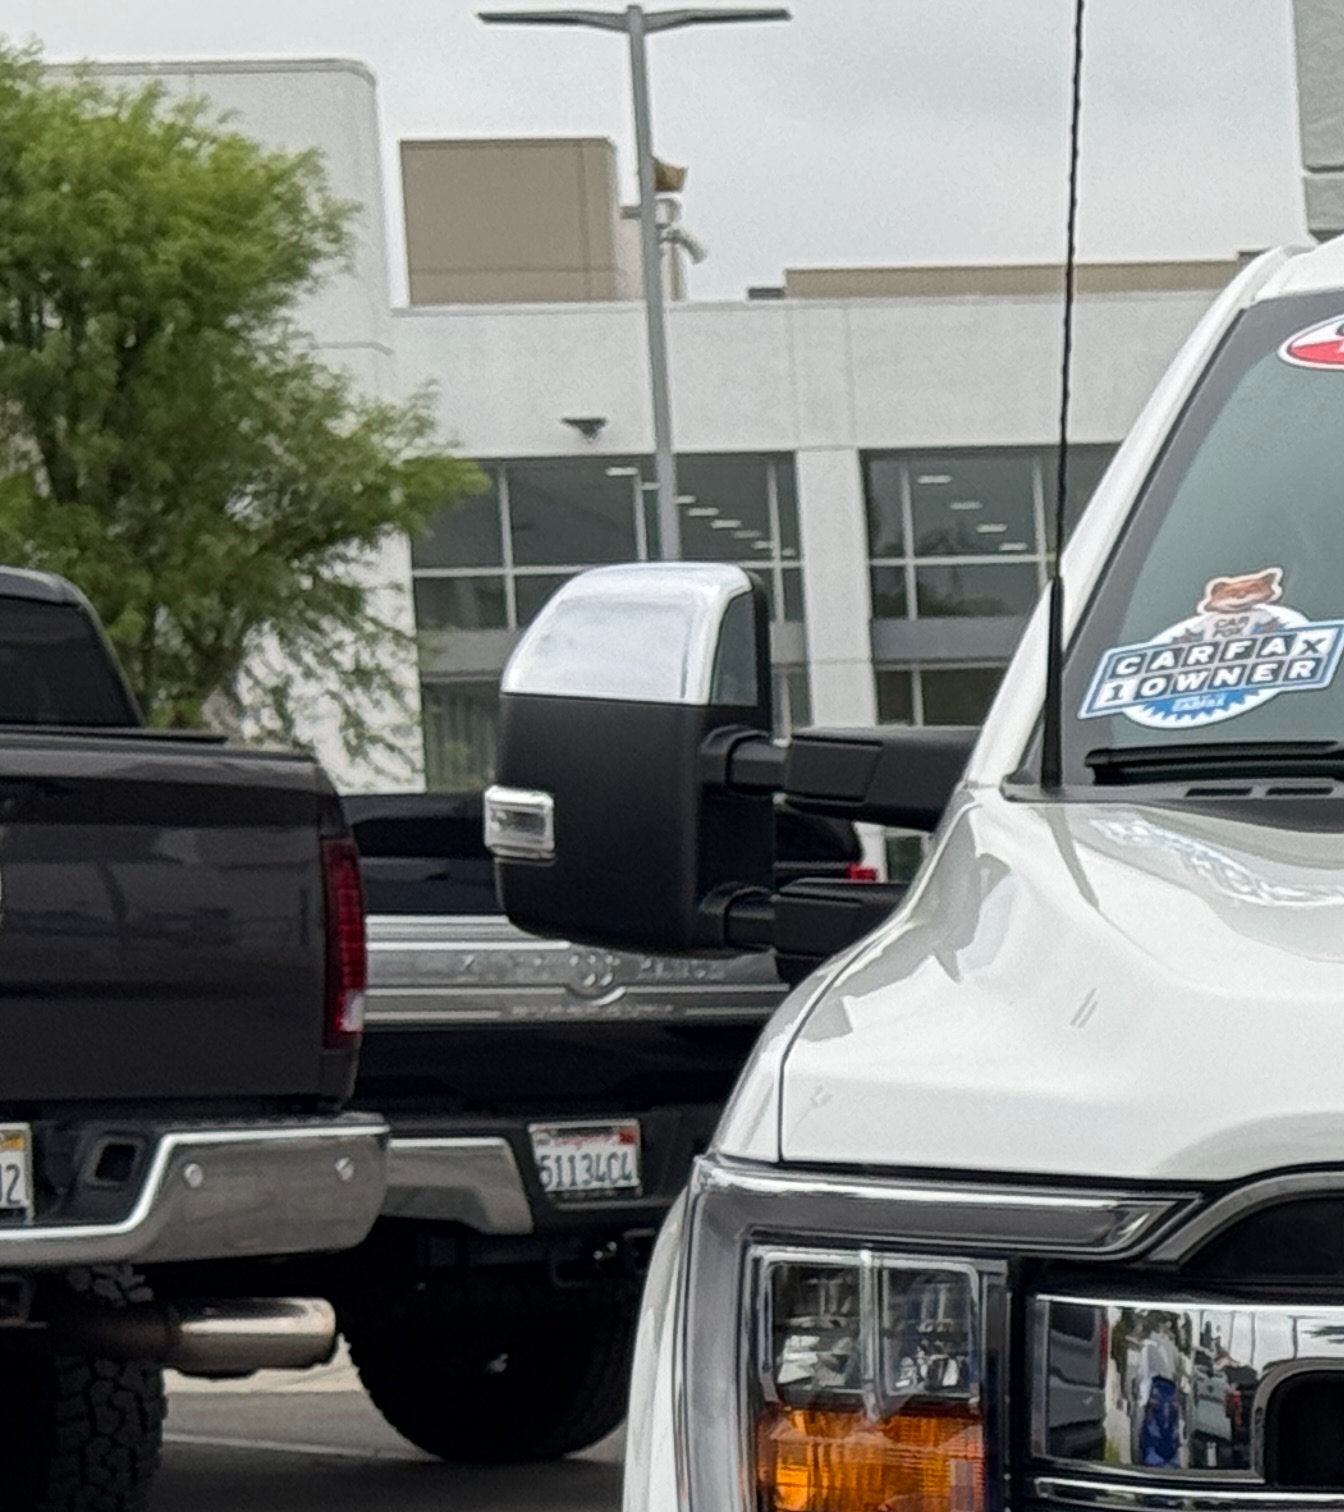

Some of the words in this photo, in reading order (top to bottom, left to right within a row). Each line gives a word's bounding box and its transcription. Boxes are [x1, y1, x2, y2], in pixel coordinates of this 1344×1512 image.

[1114, 636, 1326, 677] CARFAX
[1105, 679, 1127, 702] 1
[1140, 659, 1316, 697] OWNER
